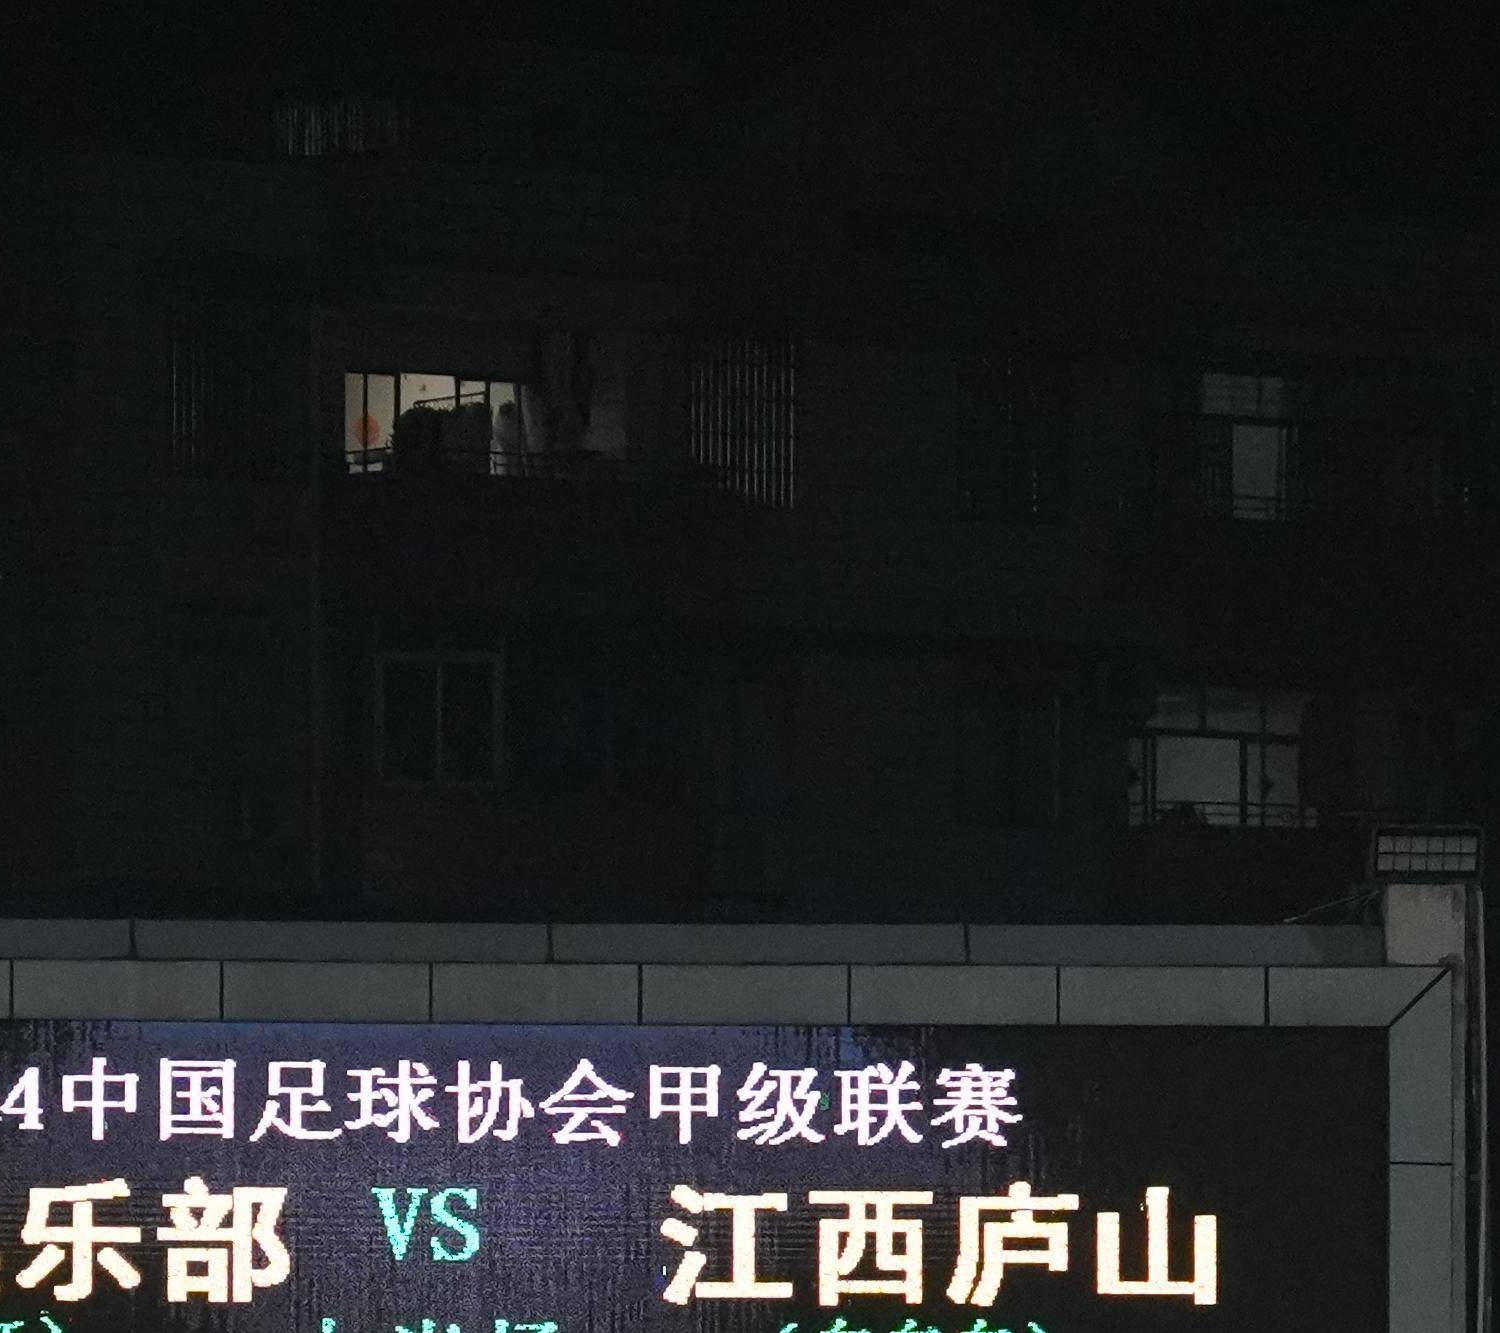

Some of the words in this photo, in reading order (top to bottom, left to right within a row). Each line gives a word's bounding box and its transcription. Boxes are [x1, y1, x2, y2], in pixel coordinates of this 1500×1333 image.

[370, 1187, 481, 1262] VS
[658, 1180, 1218, 1308] 江西庐山
